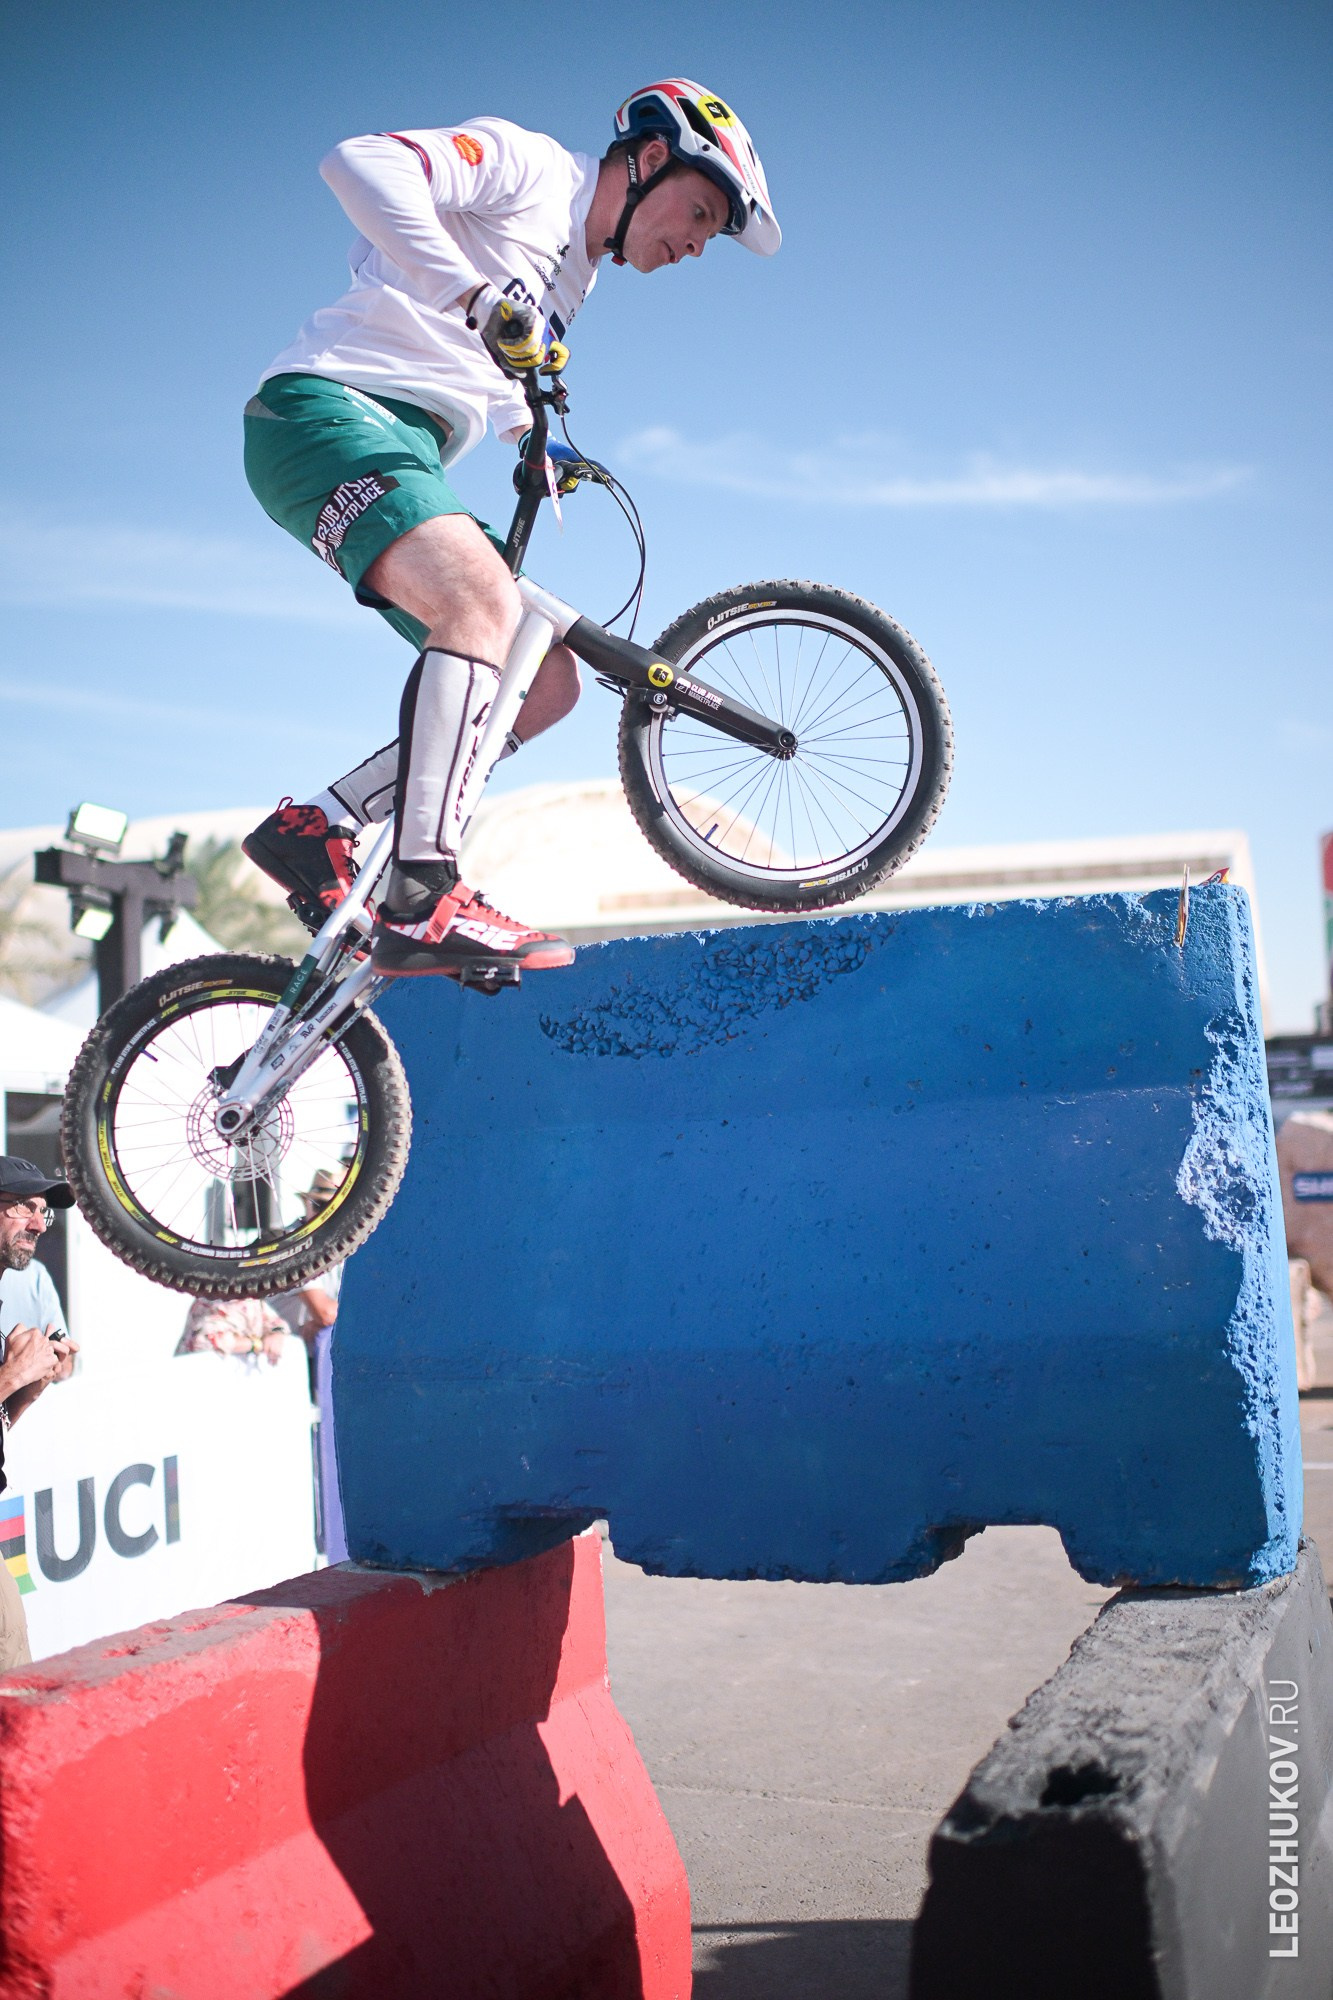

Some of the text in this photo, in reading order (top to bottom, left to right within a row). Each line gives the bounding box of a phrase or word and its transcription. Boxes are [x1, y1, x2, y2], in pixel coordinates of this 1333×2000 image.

[317, 504, 341, 541] CLUB
[512, 517, 526, 548] JITSIE
[714, 602, 750, 625] JITSIE
[687, 690, 721, 711] MARKETPLACE
[690, 683, 724, 706] CLUB JITSIE
[827, 863, 863, 886] JITSIE
[165, 980, 204, 1002] JITSIE
[289, 968, 308, 994] RACE
[34, 1454, 181, 1583] UCI
